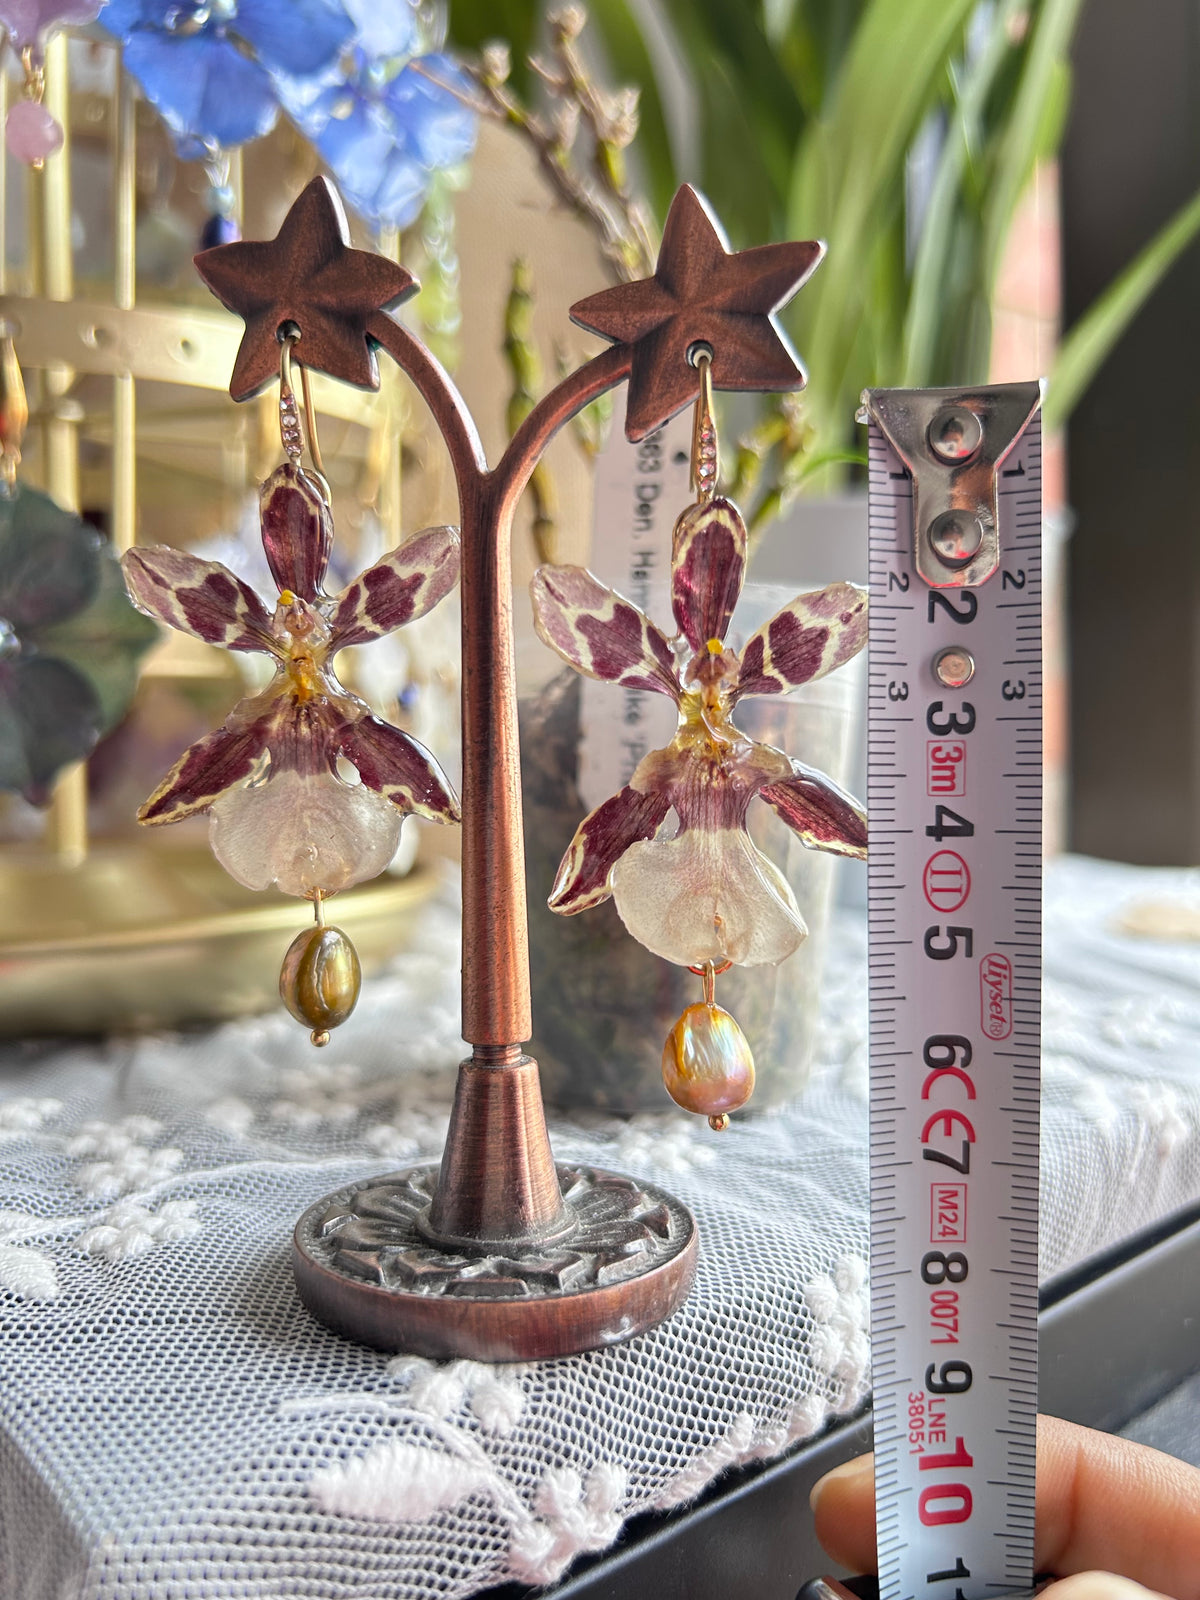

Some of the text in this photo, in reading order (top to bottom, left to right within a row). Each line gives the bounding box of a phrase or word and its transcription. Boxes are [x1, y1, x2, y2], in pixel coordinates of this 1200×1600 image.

[1003, 459, 1025, 478] 1
[888, 571, 910, 592] 2
[1002, 569, 1026, 590] 2
[927, 590, 978, 624] 2
[888, 681, 909, 702] 3
[1002, 679, 1026, 701] 3
[926, 701, 976, 736] 3
[931, 745, 963, 792] 3m
[925, 804, 974, 842] 4
[924, 925, 973, 960] 5
[923, 1034, 973, 1069] 6
[922, 1140, 970, 1174] 7
[938, 1189, 959, 1238] M24
[921, 1250, 969, 1285] 8
[930, 1290, 959, 1344] 0071
[925, 1360, 973, 1394] 9
[908, 1391, 925, 1455] 38051
[928, 1398, 946, 1444] LNE
[918, 1436, 974, 1527] 10
